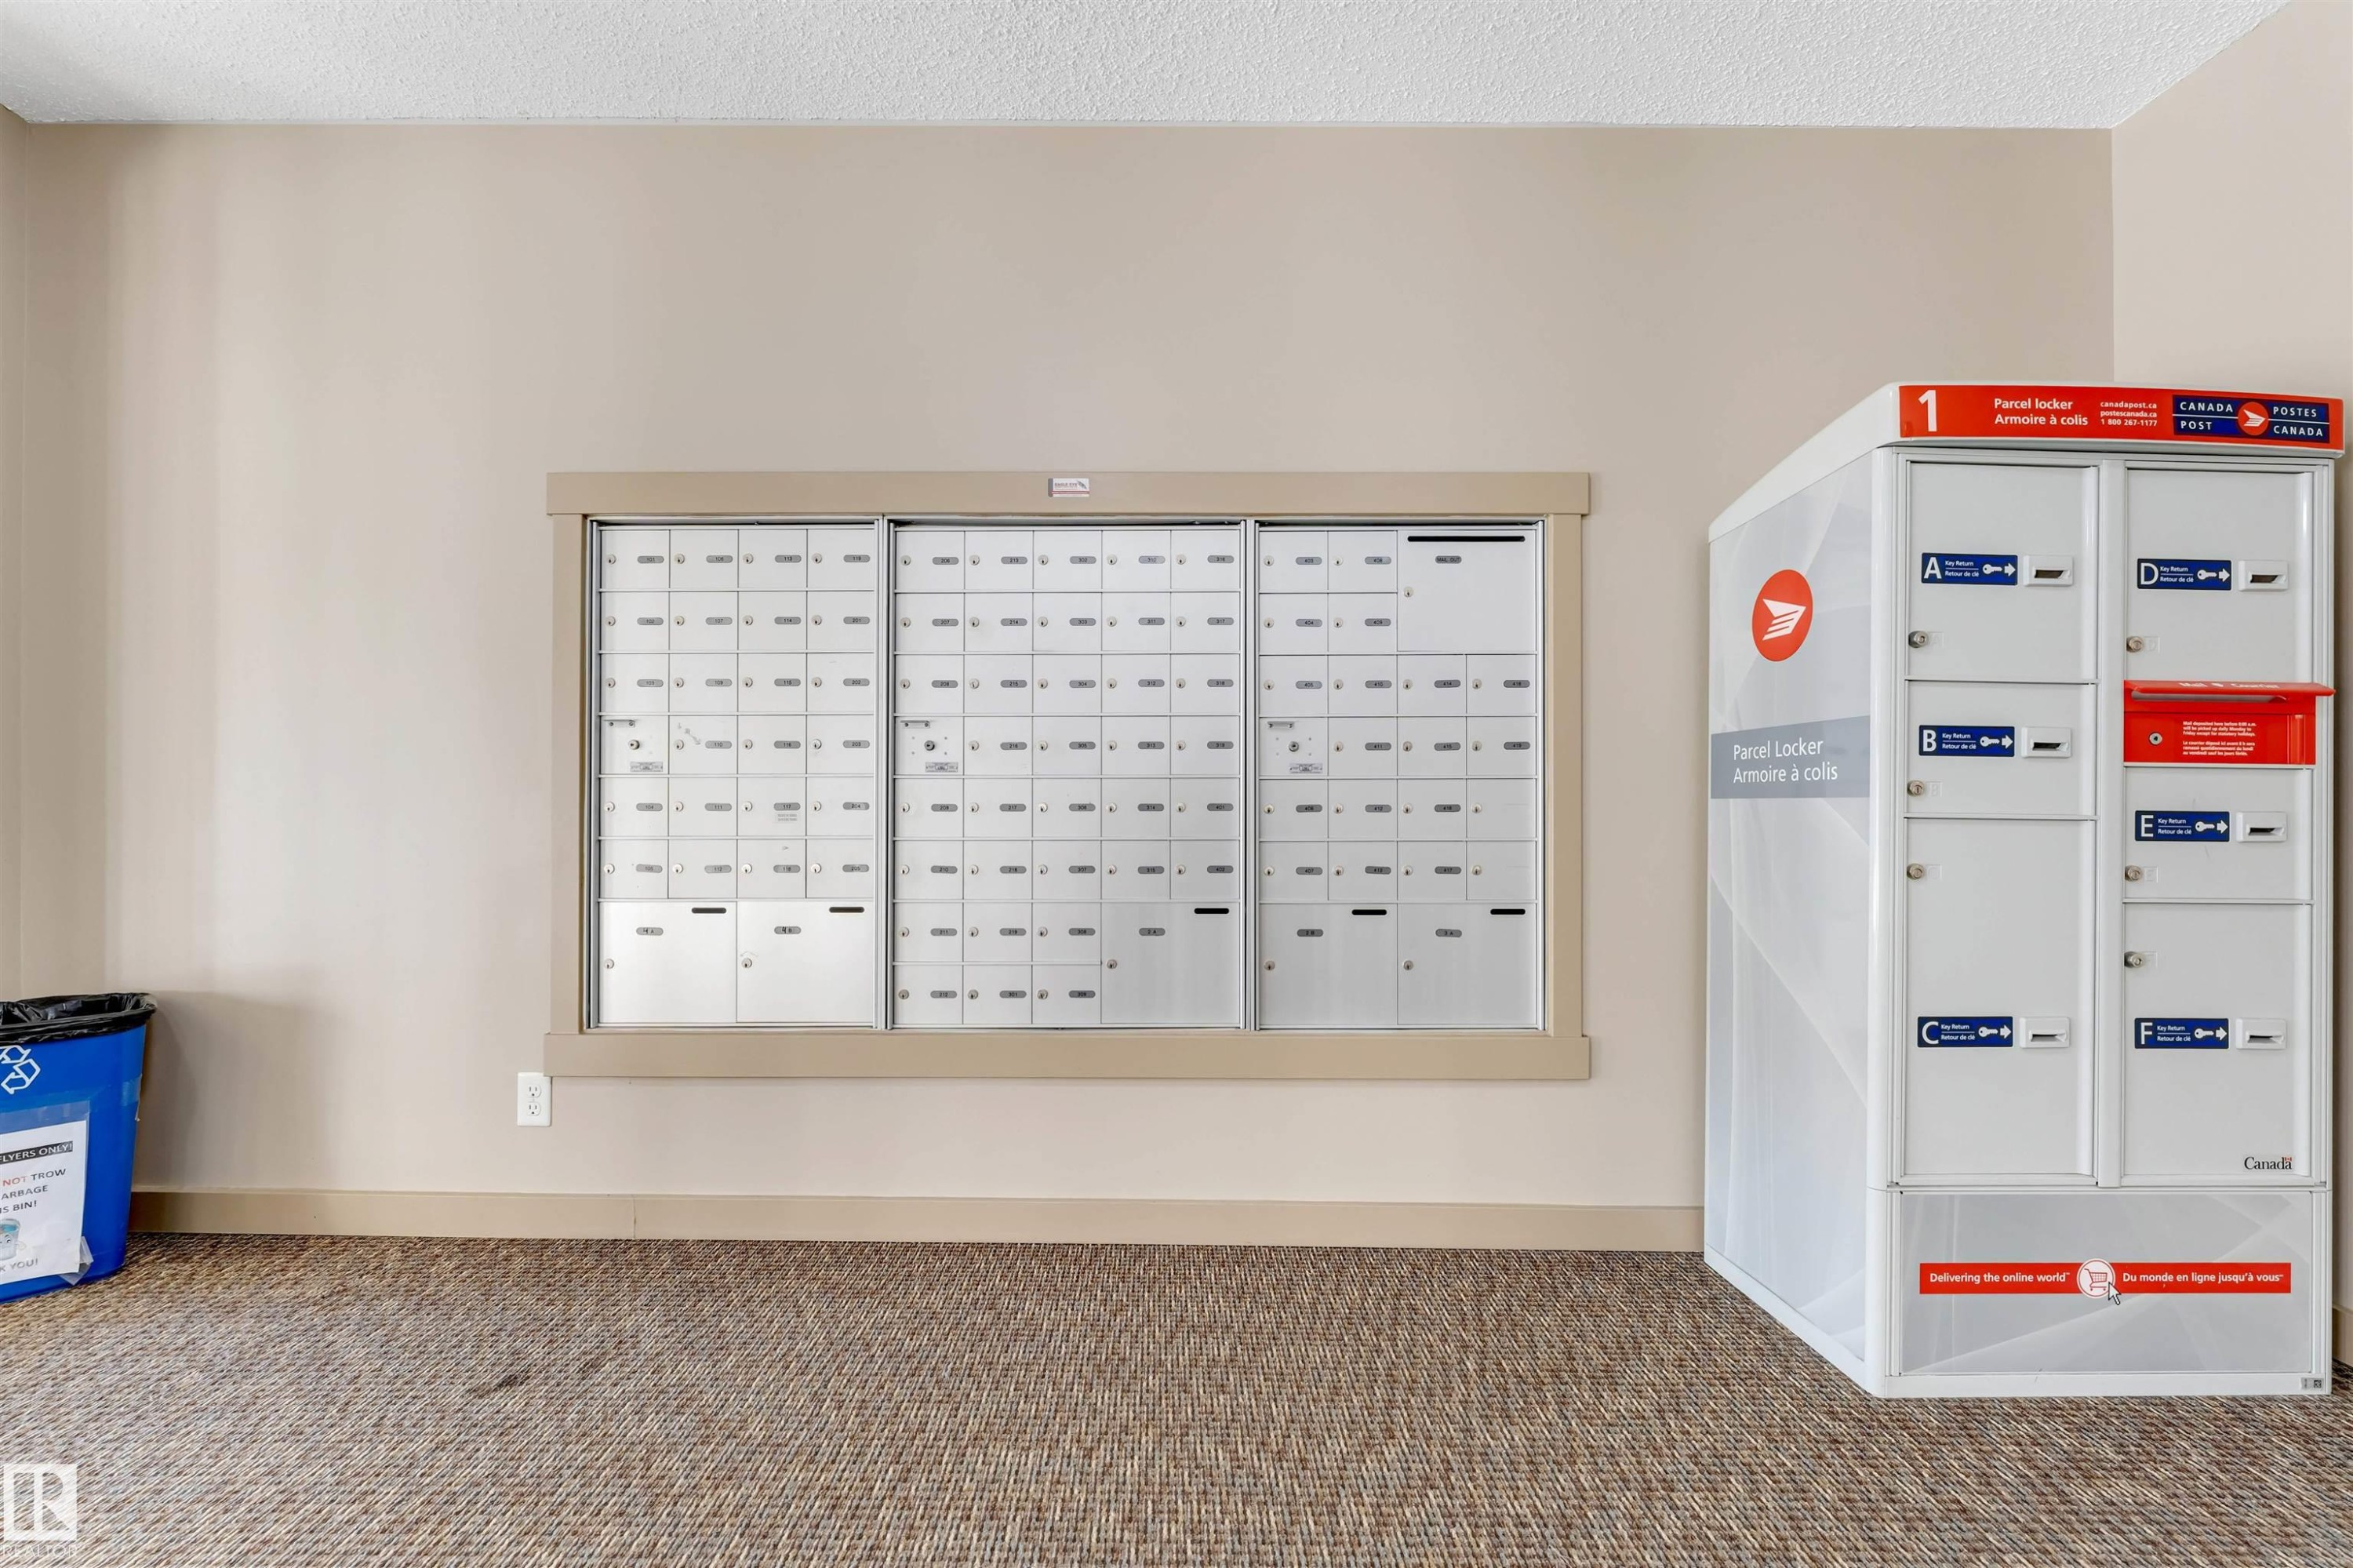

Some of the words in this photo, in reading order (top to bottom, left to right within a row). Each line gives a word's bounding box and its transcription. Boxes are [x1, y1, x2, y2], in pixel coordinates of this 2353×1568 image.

[1994, 397, 2031, 410] Parcel
[2035, 398, 2073, 410] locker
[2100, 401, 2157, 409] canadapost.ca
[2180, 401, 2234, 413] CANADA
[1918, 390, 1938, 432] 1
[2100, 410, 2157, 419] postescanada.ca
[2273, 406, 2317, 417] POSTES
[1994, 413, 2046, 425] Armoire
[2049, 413, 2058, 425] à
[2060, 413, 2089, 426] colis
[2180, 420, 2213, 430] POST
[2273, 425, 2323, 437] CANADA
[1923, 557, 1942, 579] A
[2140, 563, 2158, 585] D
[1922, 729, 1937, 751] B
[1733, 740, 1770, 760] Parcel
[1776, 737, 1823, 757] Locker
[1733, 765, 1786, 784] Armoire
[1791, 763, 1798, 780] à
[1804, 762, 1838, 780] colis
[2140, 815, 2154, 837] E
[1922, 1021, 1938, 1044] C
[2140, 1022, 2153, 1044] F
[38, 1143, 72, 1155] ONLY!
[2244, 1156, 2293, 1170] Canada
[2, 1176, 27, 1186] NOT
[31, 1169, 66, 1181] TROW
[13, 1200, 37, 1211] BIN!
[10, 1258, 38, 1269] YOU!
[1929, 1271, 1981, 1285] Delivering
[1984, 1272, 2000, 1282] the
[2002, 1272, 2034, 1282] online
[2122, 1272, 2137, 1282] Du
[2139, 1272, 2174, 1282] monde
[2191, 1272, 2216, 1286] ligne
